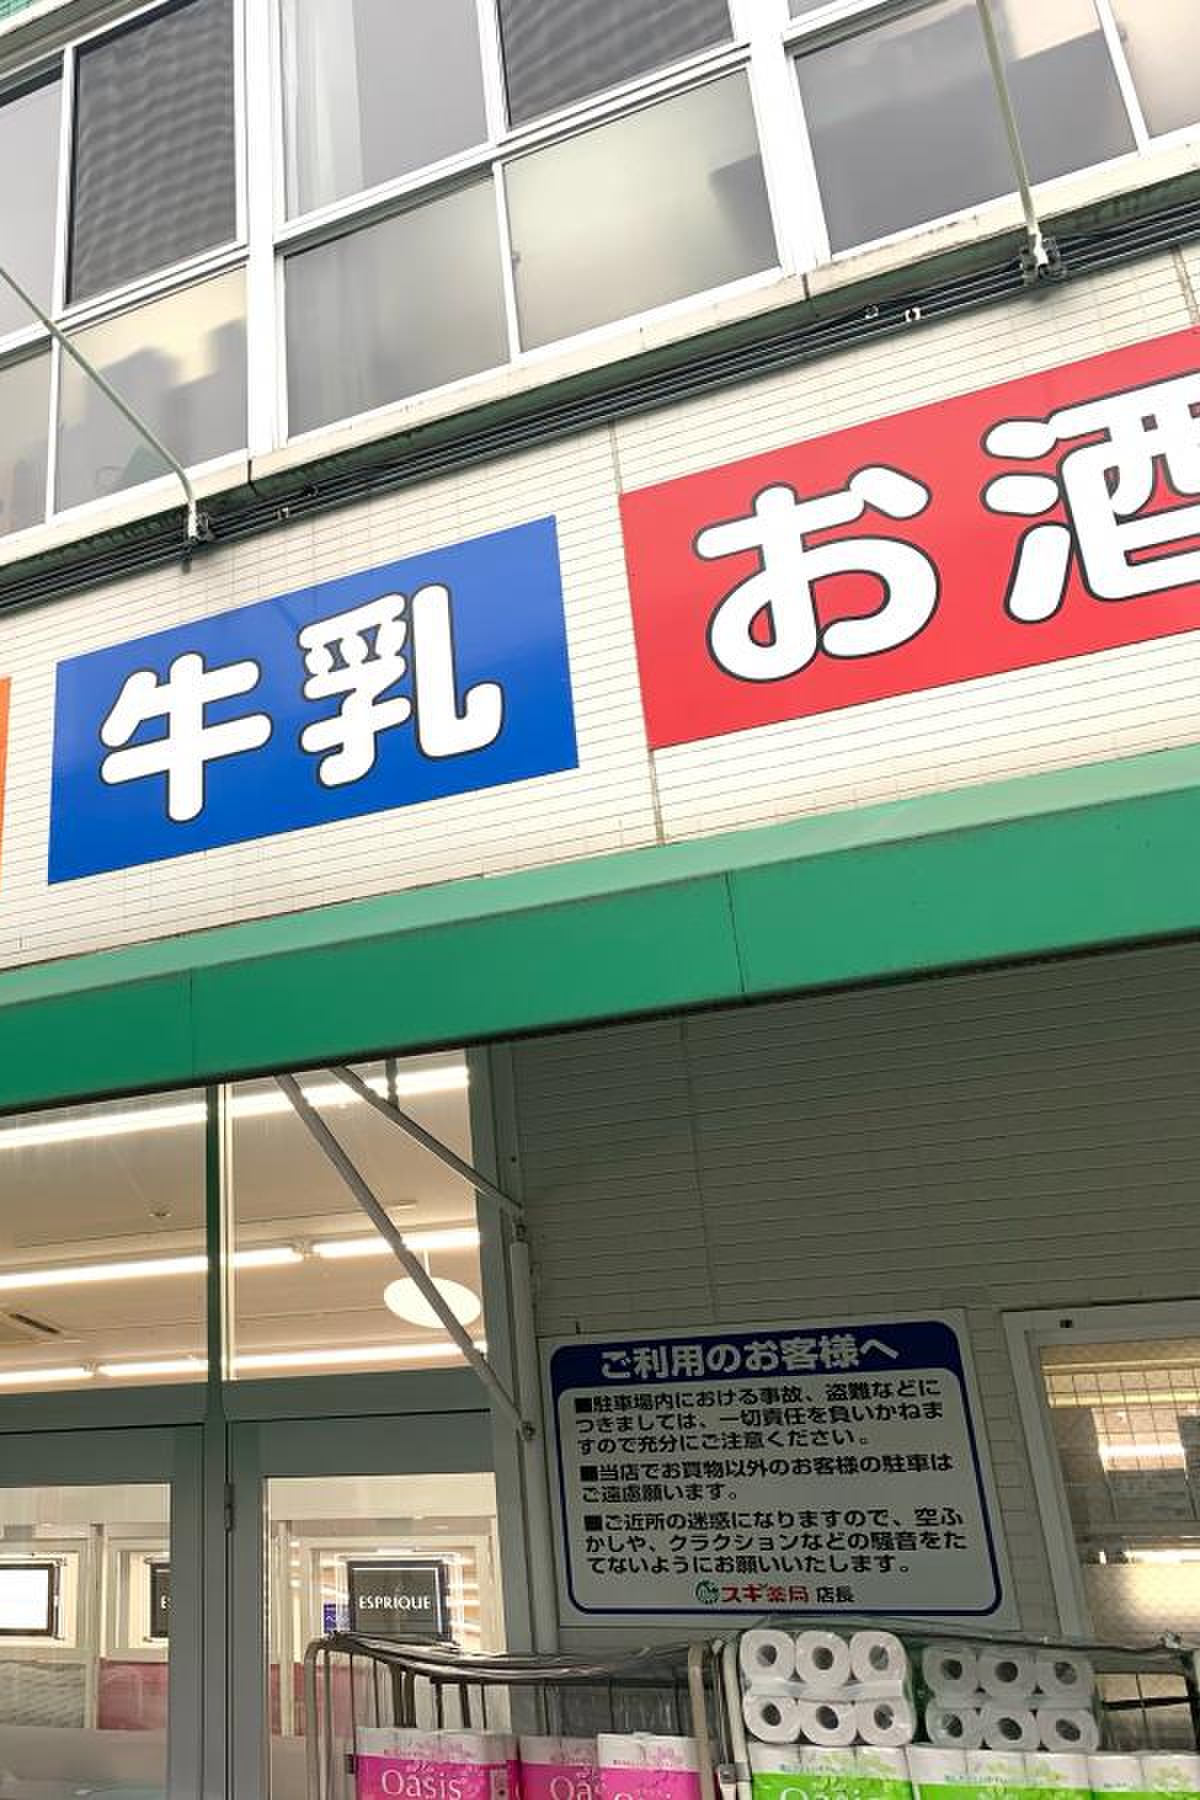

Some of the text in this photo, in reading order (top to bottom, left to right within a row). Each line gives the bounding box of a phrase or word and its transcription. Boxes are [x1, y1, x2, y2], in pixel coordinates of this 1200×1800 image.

[99, 582, 504, 823] 牛乳
[601, 1334, 900, 1380] ご利用のお客様へ
[575, 1401, 944, 1433] つきましては、一切責任を負いかねま
[578, 1429, 870, 1455] すので充分にご注意ください。
[581, 1482, 738, 1503] ご遠慮願います。
[589, 1554, 910, 1575] てないようにお願いいたします。
[358, 1595, 432, 1610] ESPRIQUE
[720, 1583, 855, 1604] スギ薬局 店長
[381, 1769, 463, 1800] Oasis
